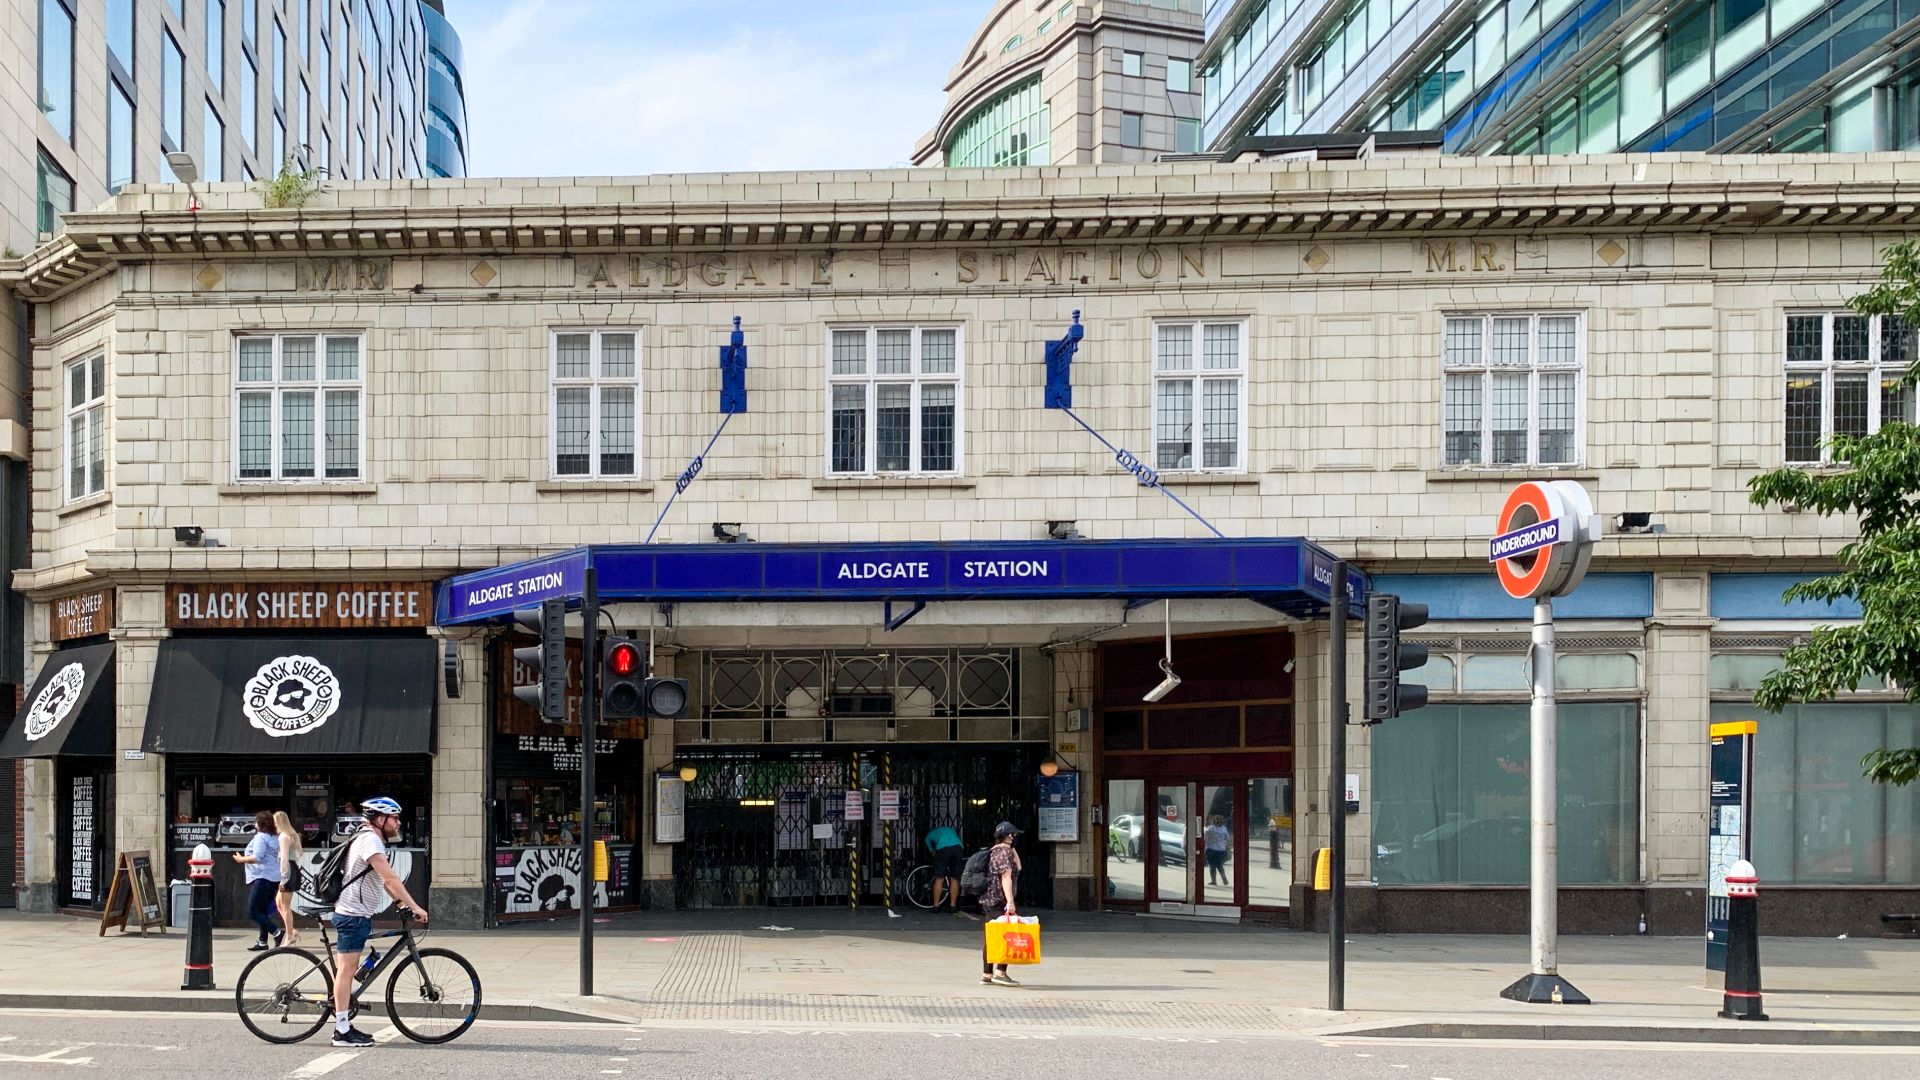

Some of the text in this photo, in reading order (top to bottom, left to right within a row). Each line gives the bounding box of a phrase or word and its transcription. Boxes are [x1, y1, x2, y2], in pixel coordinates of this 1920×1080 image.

[586, 247, 1207, 288] ALDGATE STATION
[1492, 524, 1557, 556] UNDERGROUND
[837, 560, 1048, 579] ALDGATE STATION
[468, 571, 563, 607] ALDGATE STATION
[58, 593, 103, 618] BLACK SHEEP
[178, 591, 420, 619] BLACK SHEEP COFFEE
[68, 615, 93, 635] COFFEE
[252, 660, 332, 695] BLACK SHEEP
[274, 714, 312, 730] COFFEE
[73, 786, 93, 800] COFFEE
[72, 816, 92, 831] COFFEE
[72, 846, 92, 861] COFFEE
[72, 876, 92, 892] COFFEE
[513, 850, 549, 903] BLACK
[549, 848, 581, 876] SHEE
